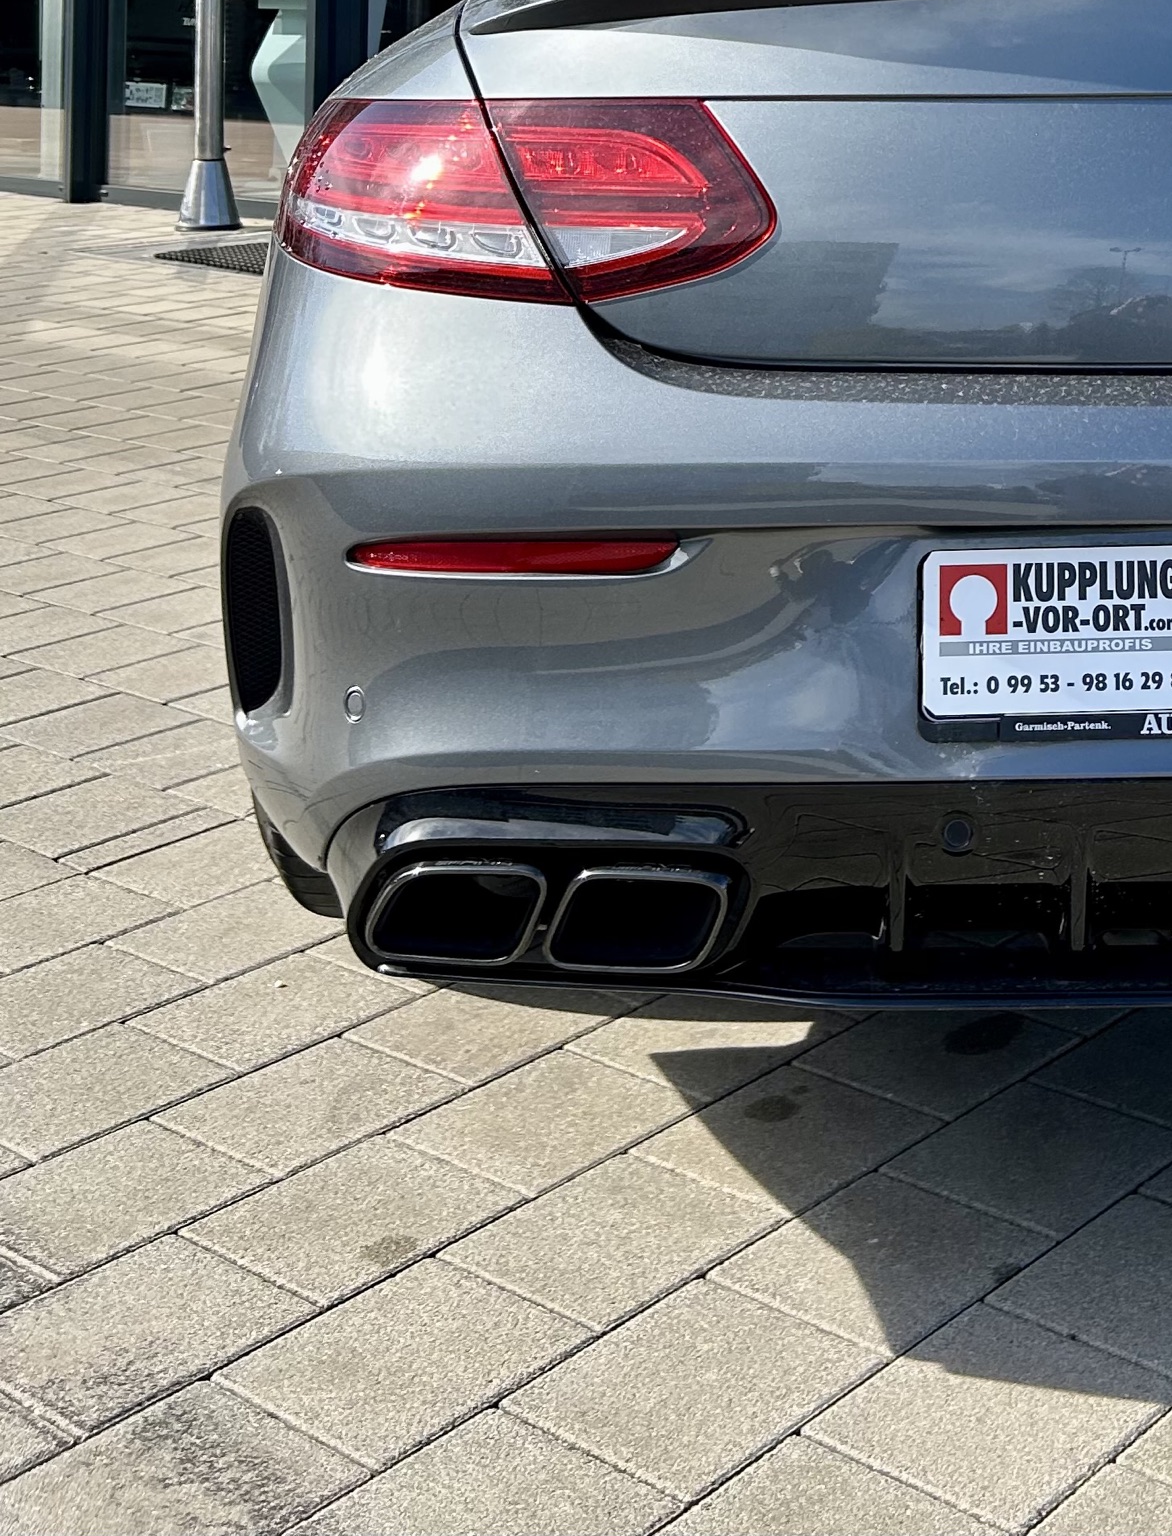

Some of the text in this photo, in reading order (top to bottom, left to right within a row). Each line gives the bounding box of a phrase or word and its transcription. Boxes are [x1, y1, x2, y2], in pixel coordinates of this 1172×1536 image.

[968, 638, 1153, 655] IHRE EINBAUPROFIS
[940, 676, 979, 696] Tel.:
[986, 675, 1000, 694] 0
[1006, 674, 1032, 694] 99
[1039, 674, 1060, 694] 53
[1081, 673, 1108, 693] 98
[1113, 672, 1134, 692] 16
[1140, 671, 1164, 691] 29
[1014, 720, 1112, 732] Garmisch-Partenk.
